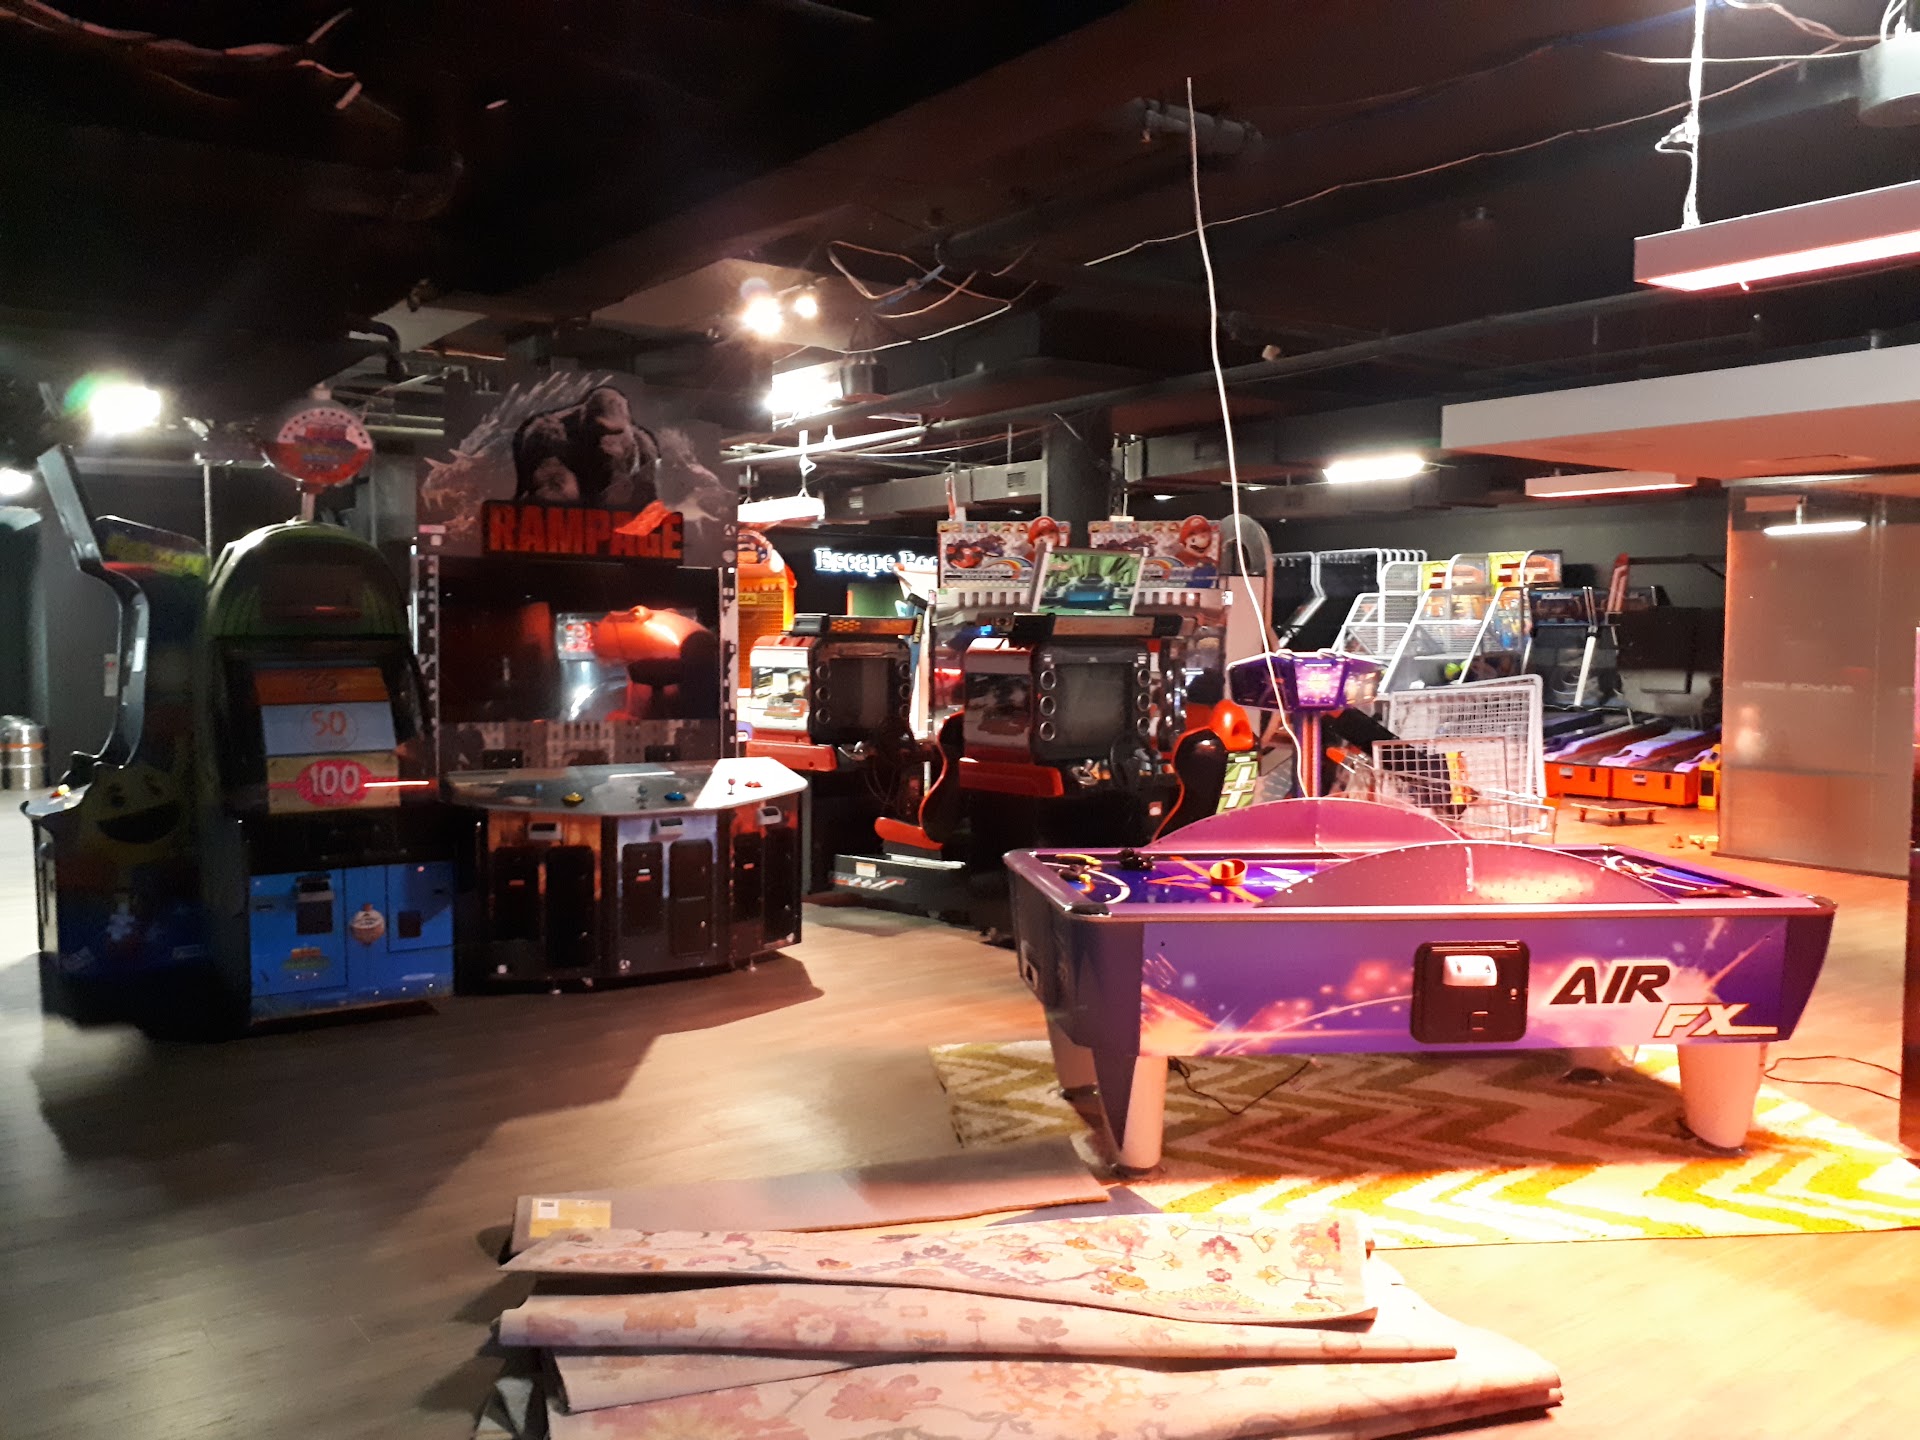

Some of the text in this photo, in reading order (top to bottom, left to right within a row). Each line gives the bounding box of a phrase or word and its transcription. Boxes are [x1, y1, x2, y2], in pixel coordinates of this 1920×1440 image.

[813, 547, 896, 577] Escape
[310, 710, 348, 737] 50
[308, 764, 361, 796] 100
[1549, 964, 1672, 1004] AIR
[1653, 1003, 1778, 1038] FX
